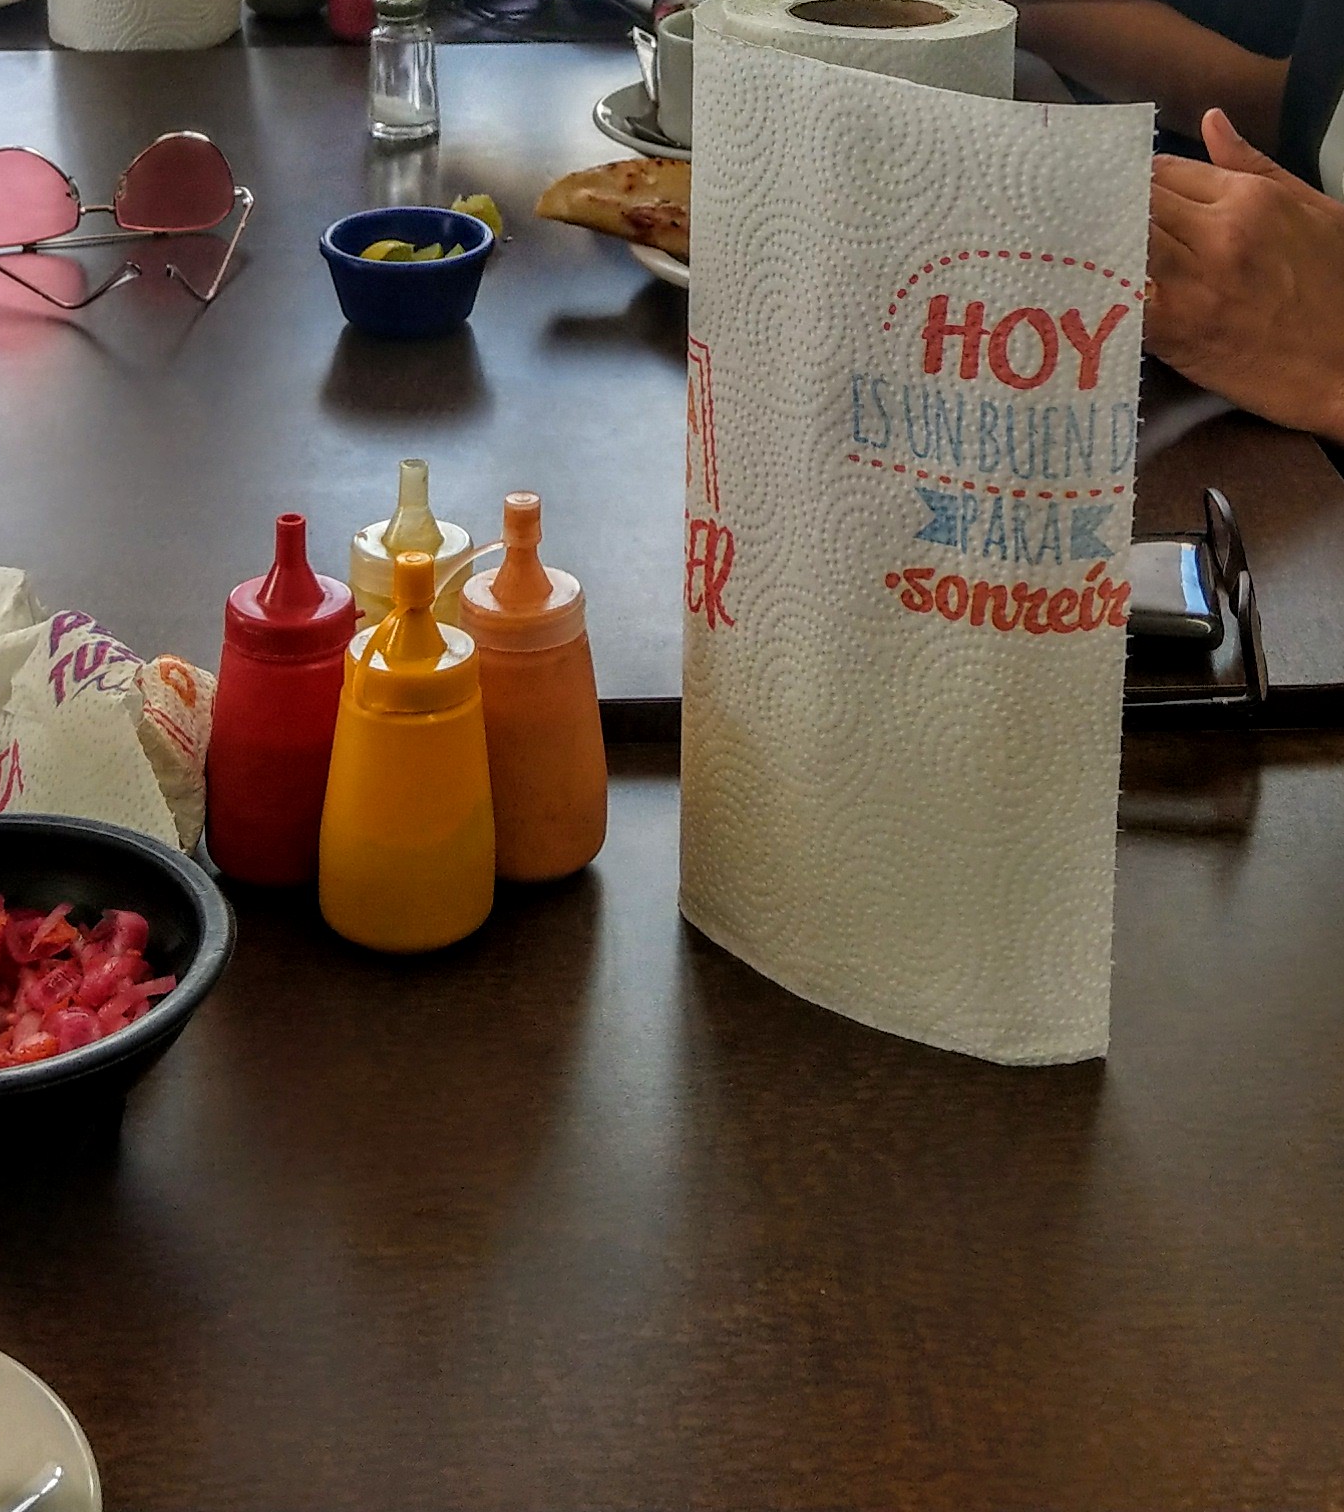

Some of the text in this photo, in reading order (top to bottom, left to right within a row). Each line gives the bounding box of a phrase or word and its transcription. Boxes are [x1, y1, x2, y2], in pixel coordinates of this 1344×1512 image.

[921, 294, 1130, 391] HOY
[852, 374, 892, 449] ES
[904, 385, 964, 467] UN
[978, 400, 1097, 480] BUEN
[959, 491, 1063, 566] PARA
